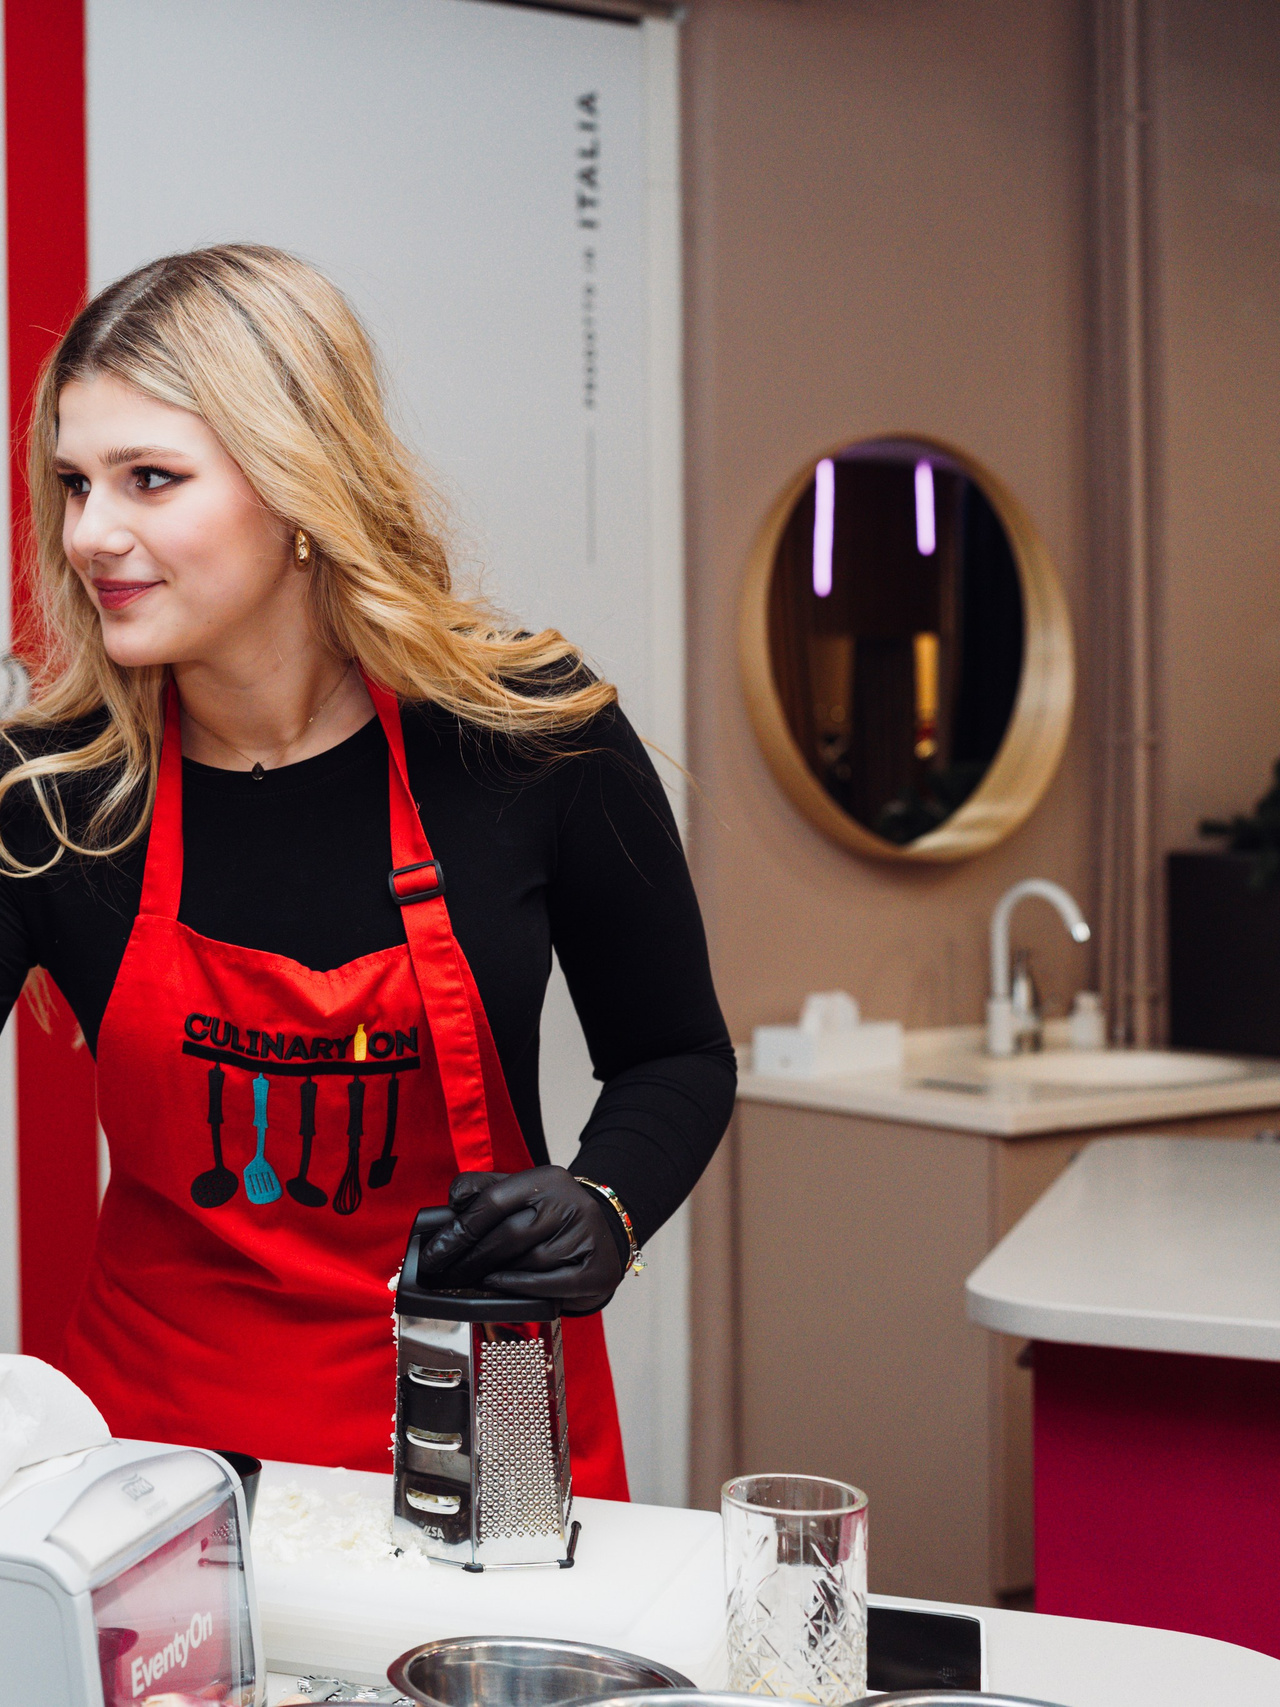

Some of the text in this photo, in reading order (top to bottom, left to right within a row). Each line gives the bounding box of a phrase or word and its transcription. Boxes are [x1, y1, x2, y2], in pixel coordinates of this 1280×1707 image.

[577, 89, 600, 230] ITALIA
[423, 1525, 445, 1539] ILSA
[131, 1611, 212, 1698] EventyOn
